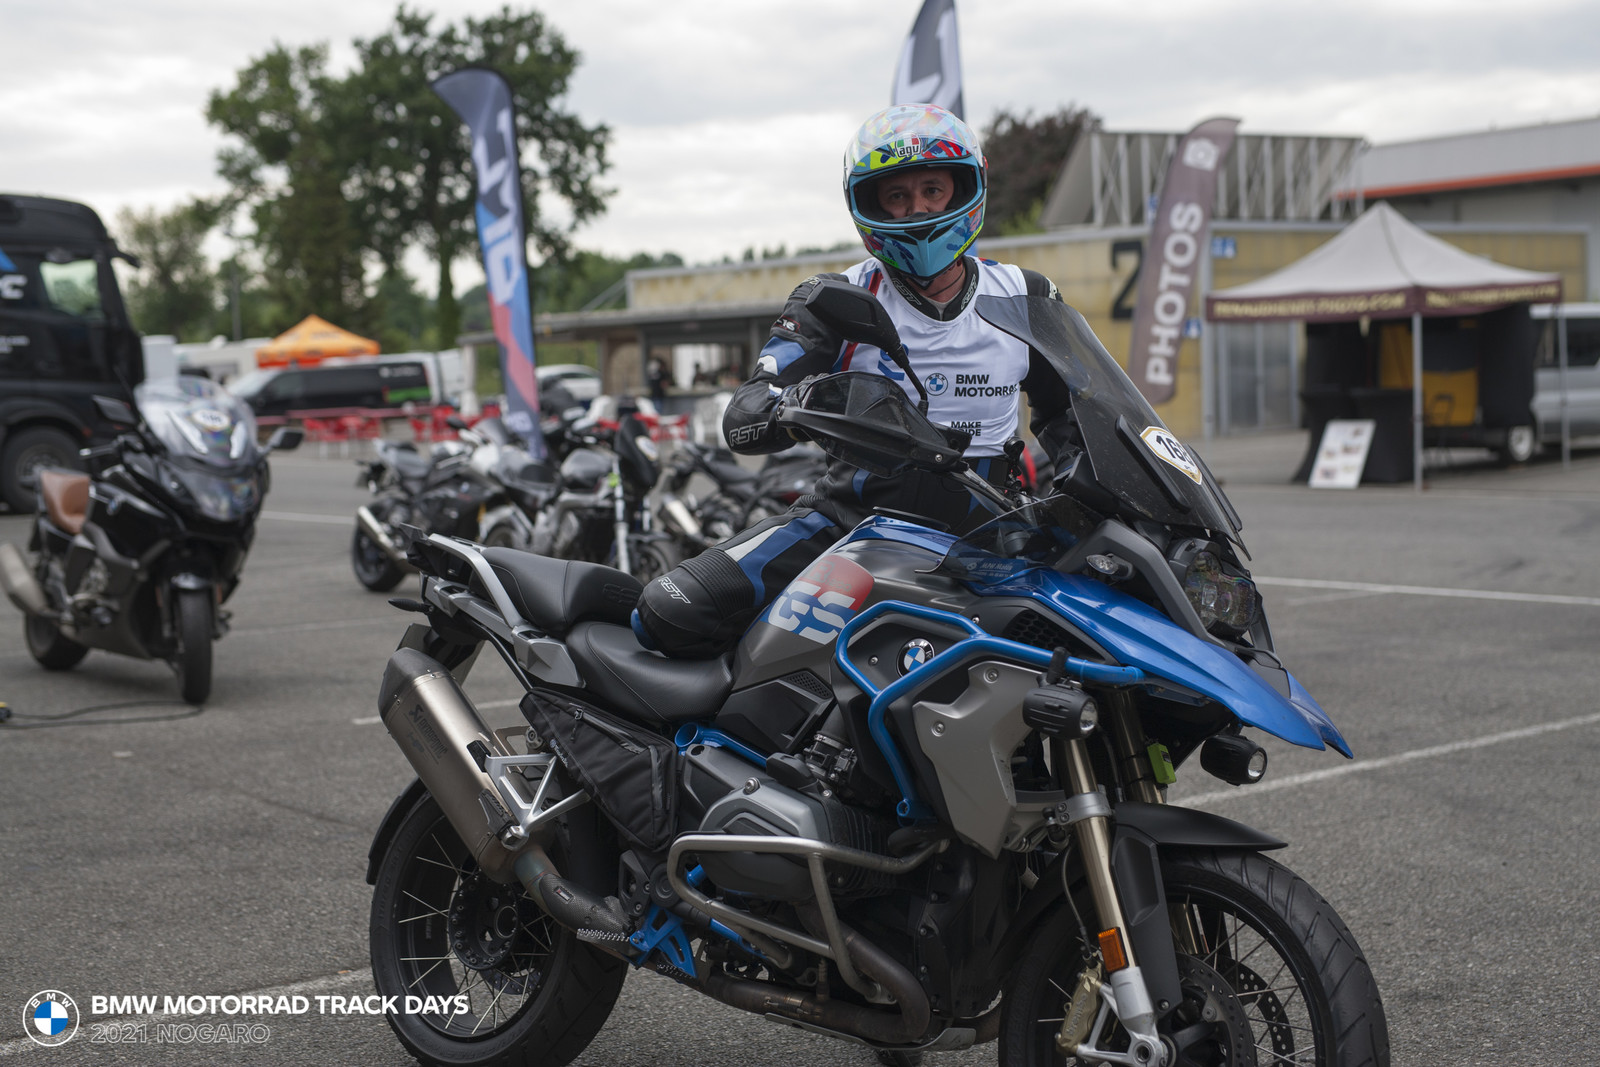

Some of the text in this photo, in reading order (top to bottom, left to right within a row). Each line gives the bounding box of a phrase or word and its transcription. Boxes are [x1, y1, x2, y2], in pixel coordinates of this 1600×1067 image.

[892, 278, 922, 306] RST
[1111, 240, 1145, 321] 2
[1145, 202, 1204, 385] PHOTOS
[955, 374, 990, 385] BMW
[729, 422, 768, 446] RST
[951, 421, 982, 429] MAKE
[659, 576, 691, 604] RST
[768, 581, 856, 645] GS
